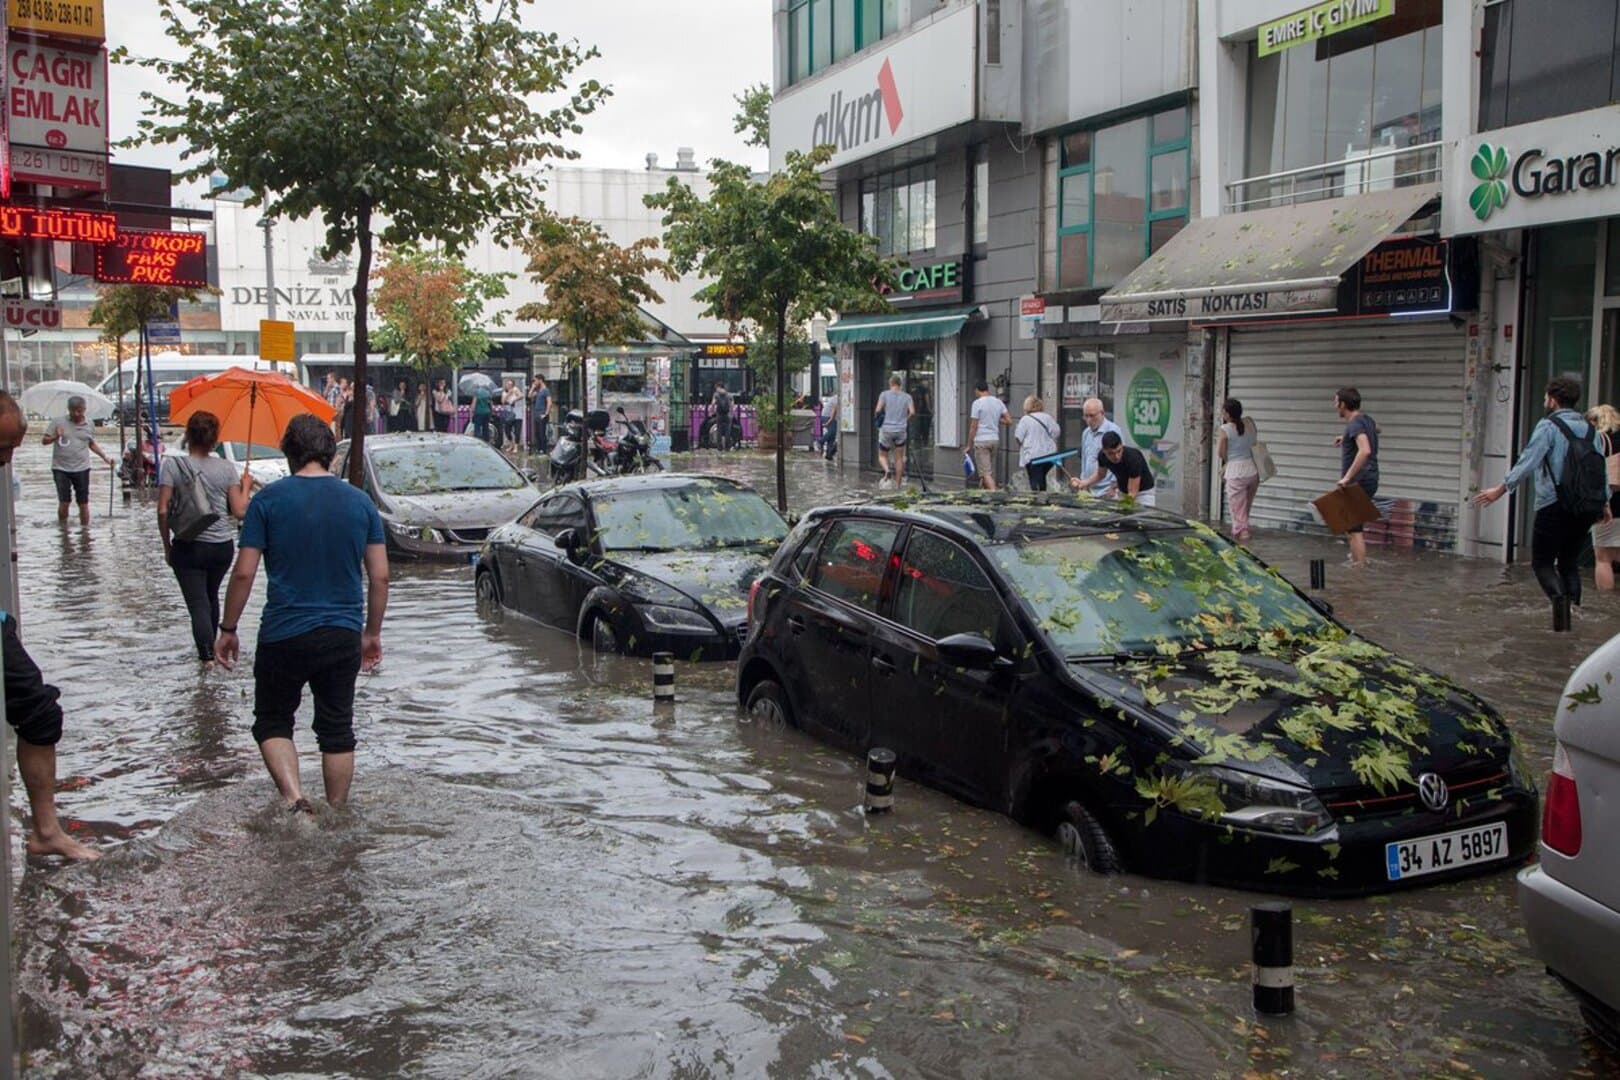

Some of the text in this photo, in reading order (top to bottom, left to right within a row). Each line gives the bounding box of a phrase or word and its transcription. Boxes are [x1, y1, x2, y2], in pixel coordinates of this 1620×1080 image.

[1264, 19, 1305, 47] EMRE
[1309, 10, 1326, 34] İÇ
[12, 49, 92, 89] ÇAĞRI
[11, 87, 101, 128] EMLAK
[126, 251, 176, 266] FAKS
[1365, 245, 1442, 272] THERMAL
[131, 265, 172, 282] PVC
[899, 262, 956, 291] CAFE
[288, 310, 330, 321] NAVAL
[1148, 299, 1186, 317] SATIŞ
[1201, 292, 1268, 313] NOKTASI
[1400, 828, 1502, 873] 34 AZ 5897
